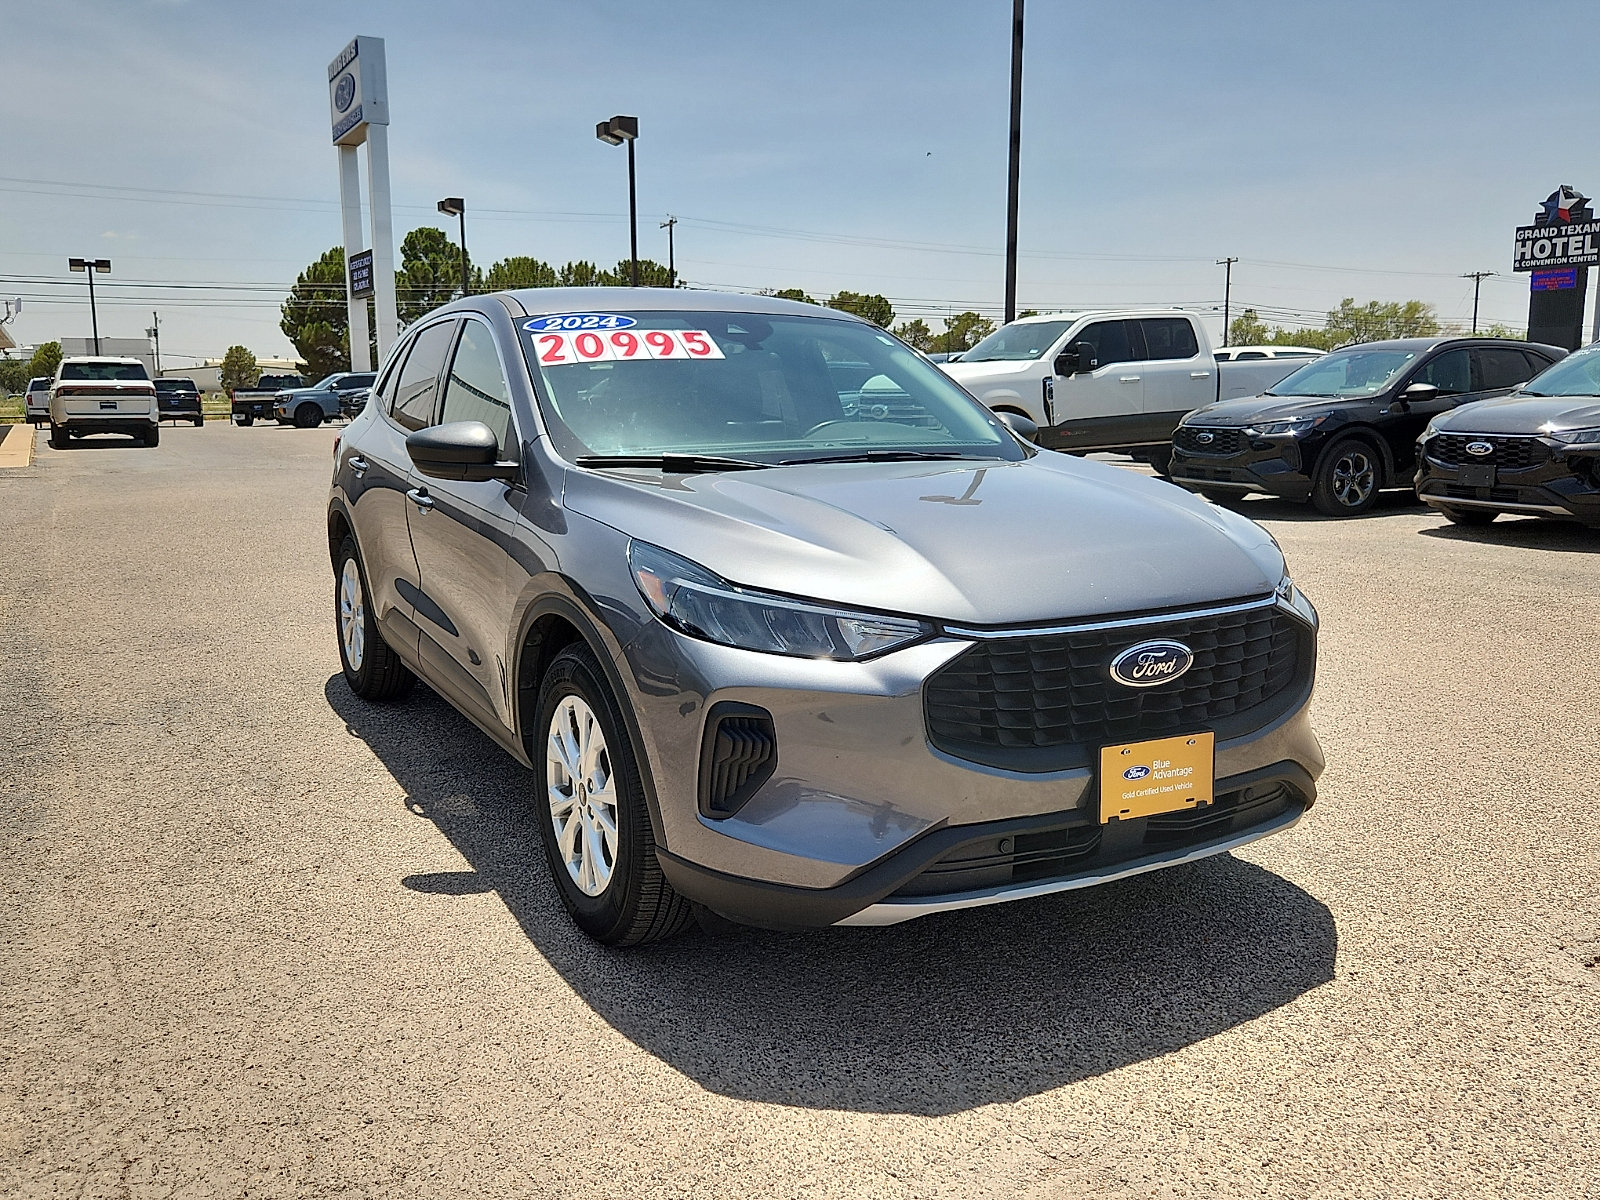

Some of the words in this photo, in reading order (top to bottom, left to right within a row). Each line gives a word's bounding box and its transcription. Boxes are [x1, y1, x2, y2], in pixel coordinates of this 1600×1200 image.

[1517, 227, 1558, 240] GRAND
[1560, 222, 1600, 236] TEXAN
[1515, 235, 1598, 260] HOTEL
[1522, 257, 1568, 267] CONVENTION
[1569, 255, 1597, 263] CENTER
[544, 316, 620, 331] 2024
[538, 332, 711, 362] 20995
[1132, 651, 1177, 679] Ford
[1128, 767, 1146, 778] Ford
[1153, 760, 1170, 770] Blue
[1153, 767, 1193, 780] Advantage
[1122, 791, 1135, 799] Gold
[1136, 786, 1159, 797] Certified
[1160, 784, 1173, 792] Used
[1174, 782, 1193, 790] Vehicle
